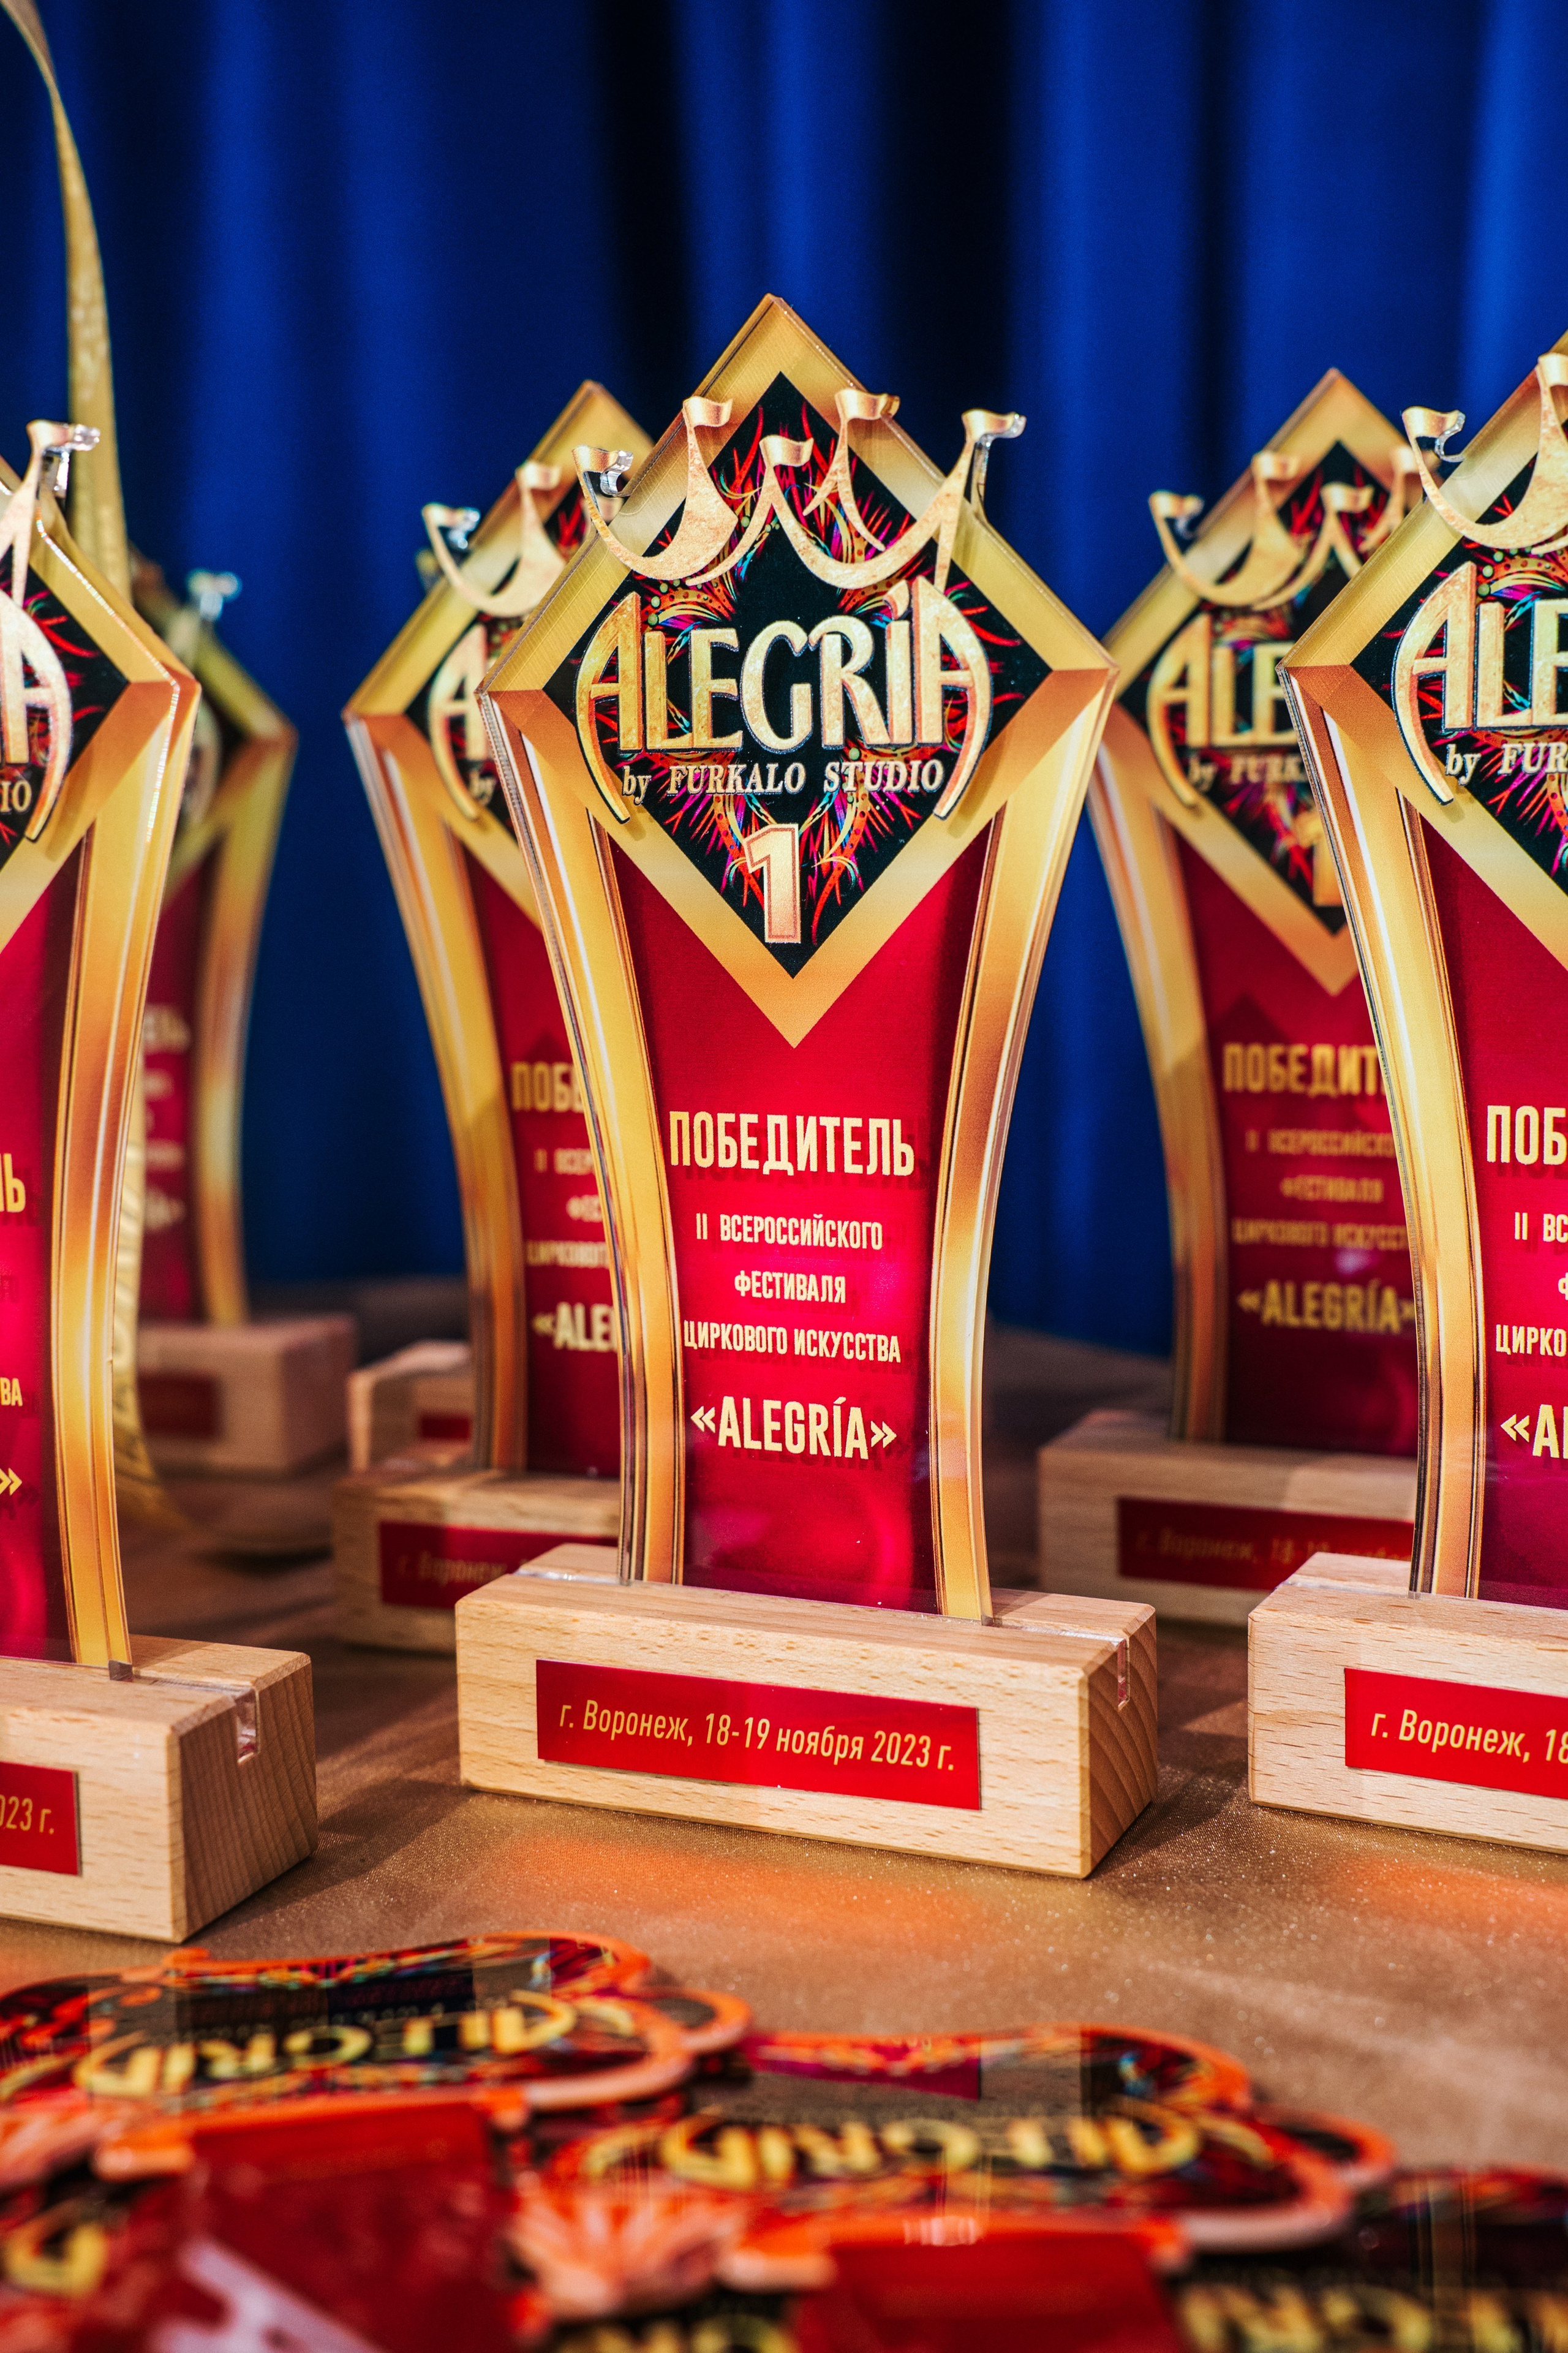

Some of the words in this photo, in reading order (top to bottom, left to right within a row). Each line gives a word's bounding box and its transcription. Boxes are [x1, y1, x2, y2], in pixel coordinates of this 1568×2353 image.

[575, 576, 994, 823] ALEGRÍA
[622, 765, 652, 805] by
[666, 762, 807, 795] FURKALO
[823, 758, 946, 794] STUDIO
[1446, 744, 1481, 785] by
[745, 823, 802, 943] 1
[669, 1111, 914, 1176] ПОБЕДИТЕЛЬ
[696, 1213, 707, 1240] II
[720, 1214, 883, 1250] ВСЕРОССИЙСКОГО
[734, 1271, 846, 1304] ФЕСТИВАЛЯ
[684, 1321, 787, 1354] ЦИРКОВОГО
[794, 1329, 901, 1362] ИСКУССТВА
[690, 1396, 897, 1459] «ALEGRÍA»
[1500, 1404, 1568, 1459] «A
[560, 1702, 574, 1728] г.
[583, 1700, 693, 1747] Воронеж,
[706, 1713, 770, 1750] 18-19
[776, 1726, 864, 1766] ноября
[871, 1731, 931, 1767] 2023
[937, 1745, 954, 1771] г.
[1371, 1713, 1388, 1738] г.
[1399, 1709, 1530, 1763] Воронеж,
